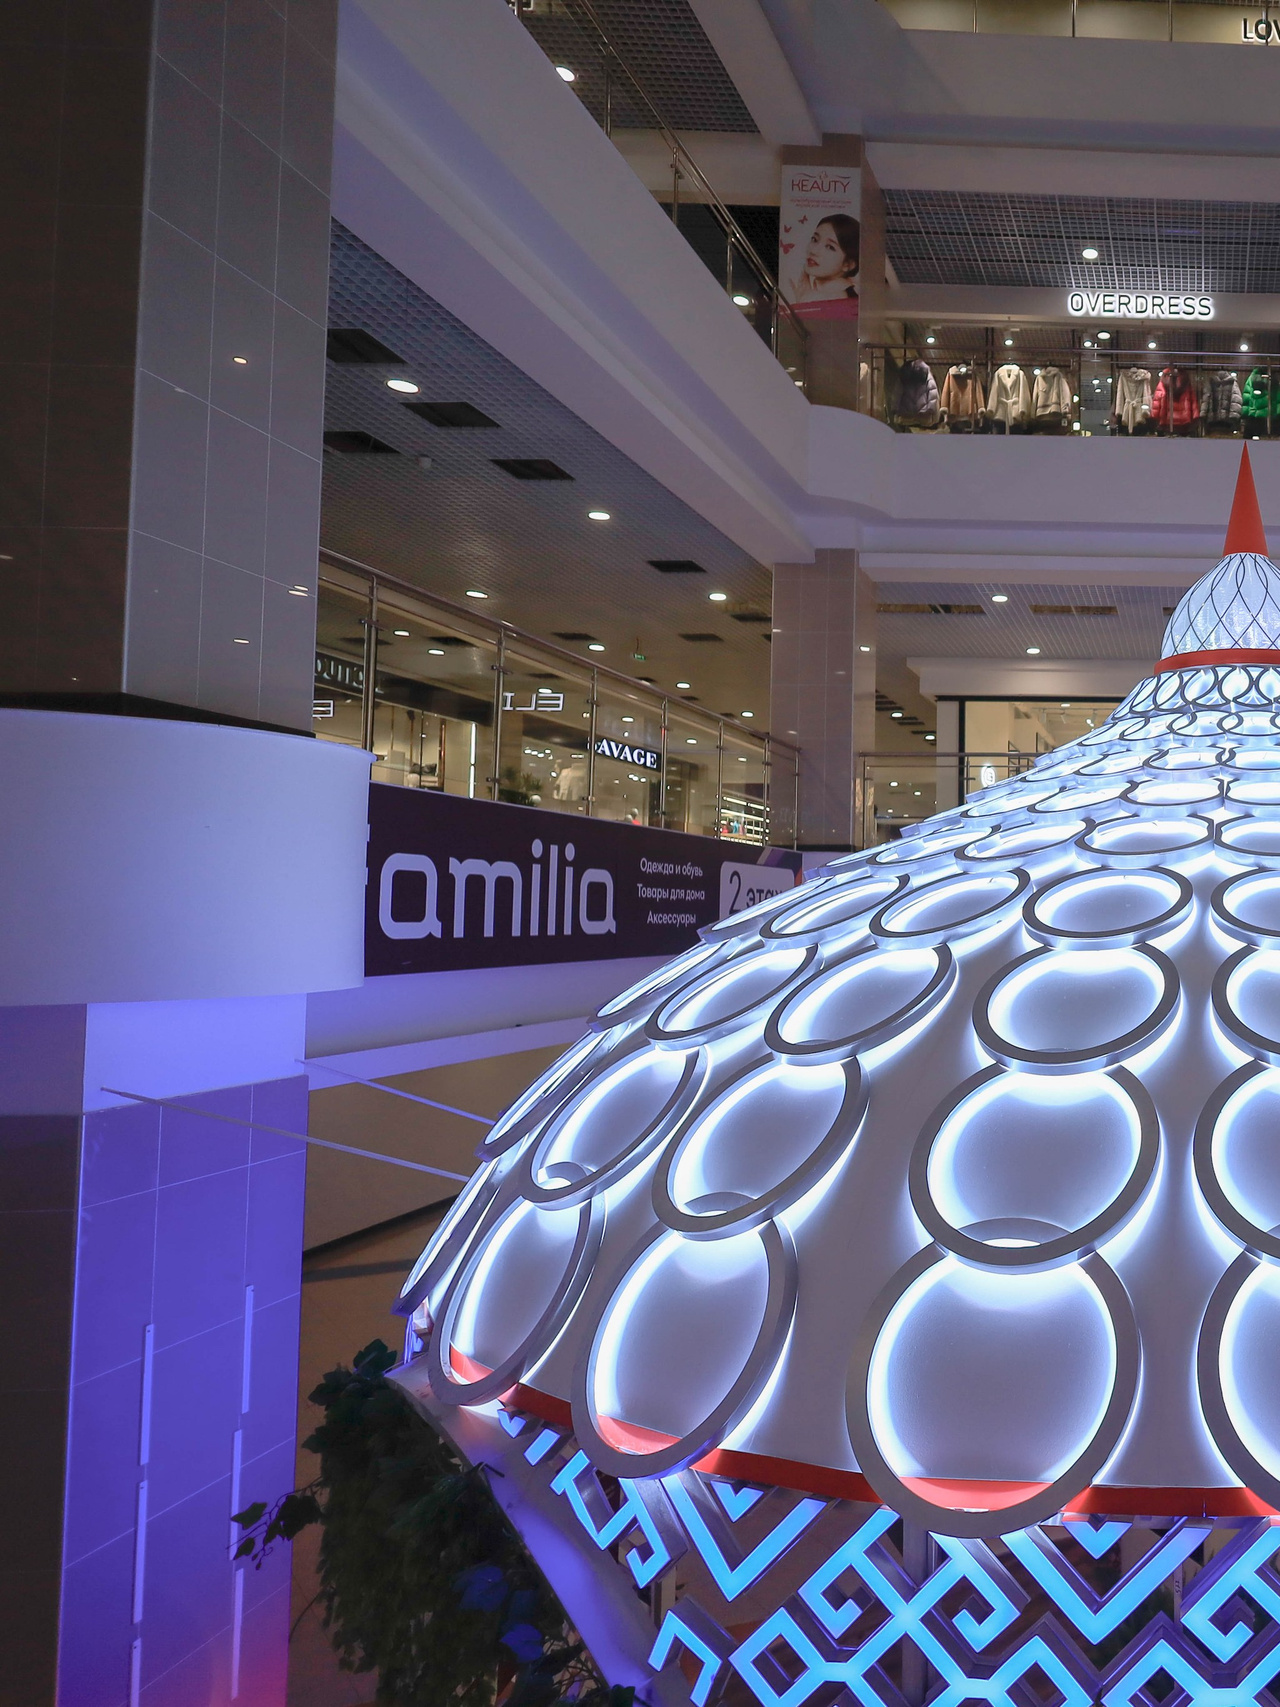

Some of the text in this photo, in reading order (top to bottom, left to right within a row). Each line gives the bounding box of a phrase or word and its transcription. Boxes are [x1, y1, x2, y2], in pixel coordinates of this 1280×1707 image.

[1069, 292, 1213, 319] OVERDRESS
[639, 857, 704, 879] Одежда и обувь
[366, 824, 617, 940] amilia
[637, 883, 705, 902] Товары для дома
[729, 870, 784, 915] 2 эта
[646, 911, 697, 928] Аксессуары
